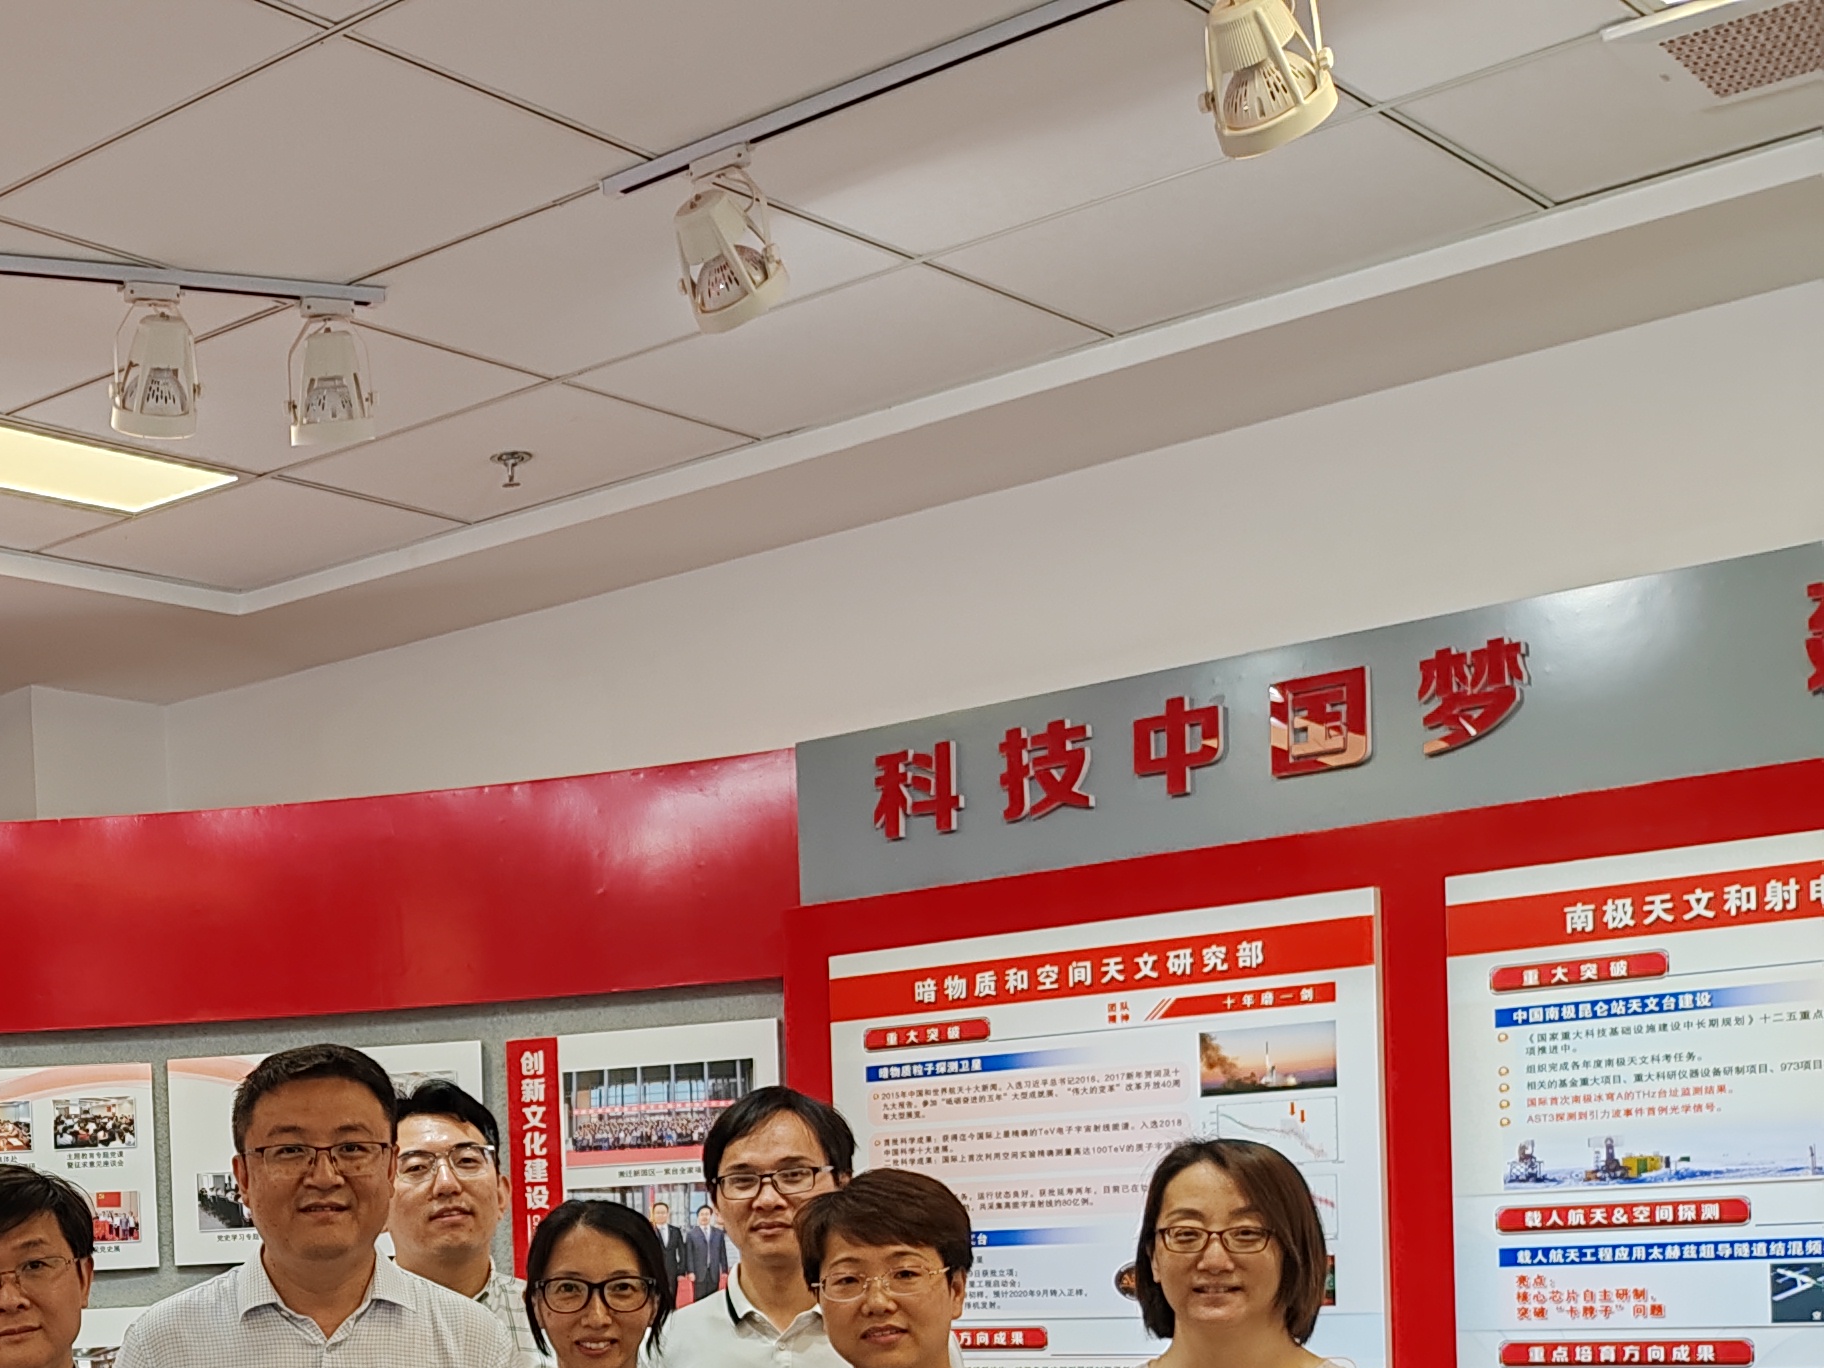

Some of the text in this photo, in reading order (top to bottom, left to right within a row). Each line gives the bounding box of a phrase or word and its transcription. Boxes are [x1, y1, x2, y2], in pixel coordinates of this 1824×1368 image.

[873, 637, 1530, 841] 科技中国梦
[914, 940, 1266, 1004] 暗物质和空间天文研究部
[1522, 960, 1629, 986] 重大突破
[1222, 987, 1315, 1010] 十年磨一剑
[1512, 992, 1713, 1024] 中国南极昆仑站天文台建设
[885, 1025, 961, 1047] 重大突破
[520, 1050, 550, 1210] 创新文化建设
[1528, 1345, 1716, 1364] 重点培育方向成果
